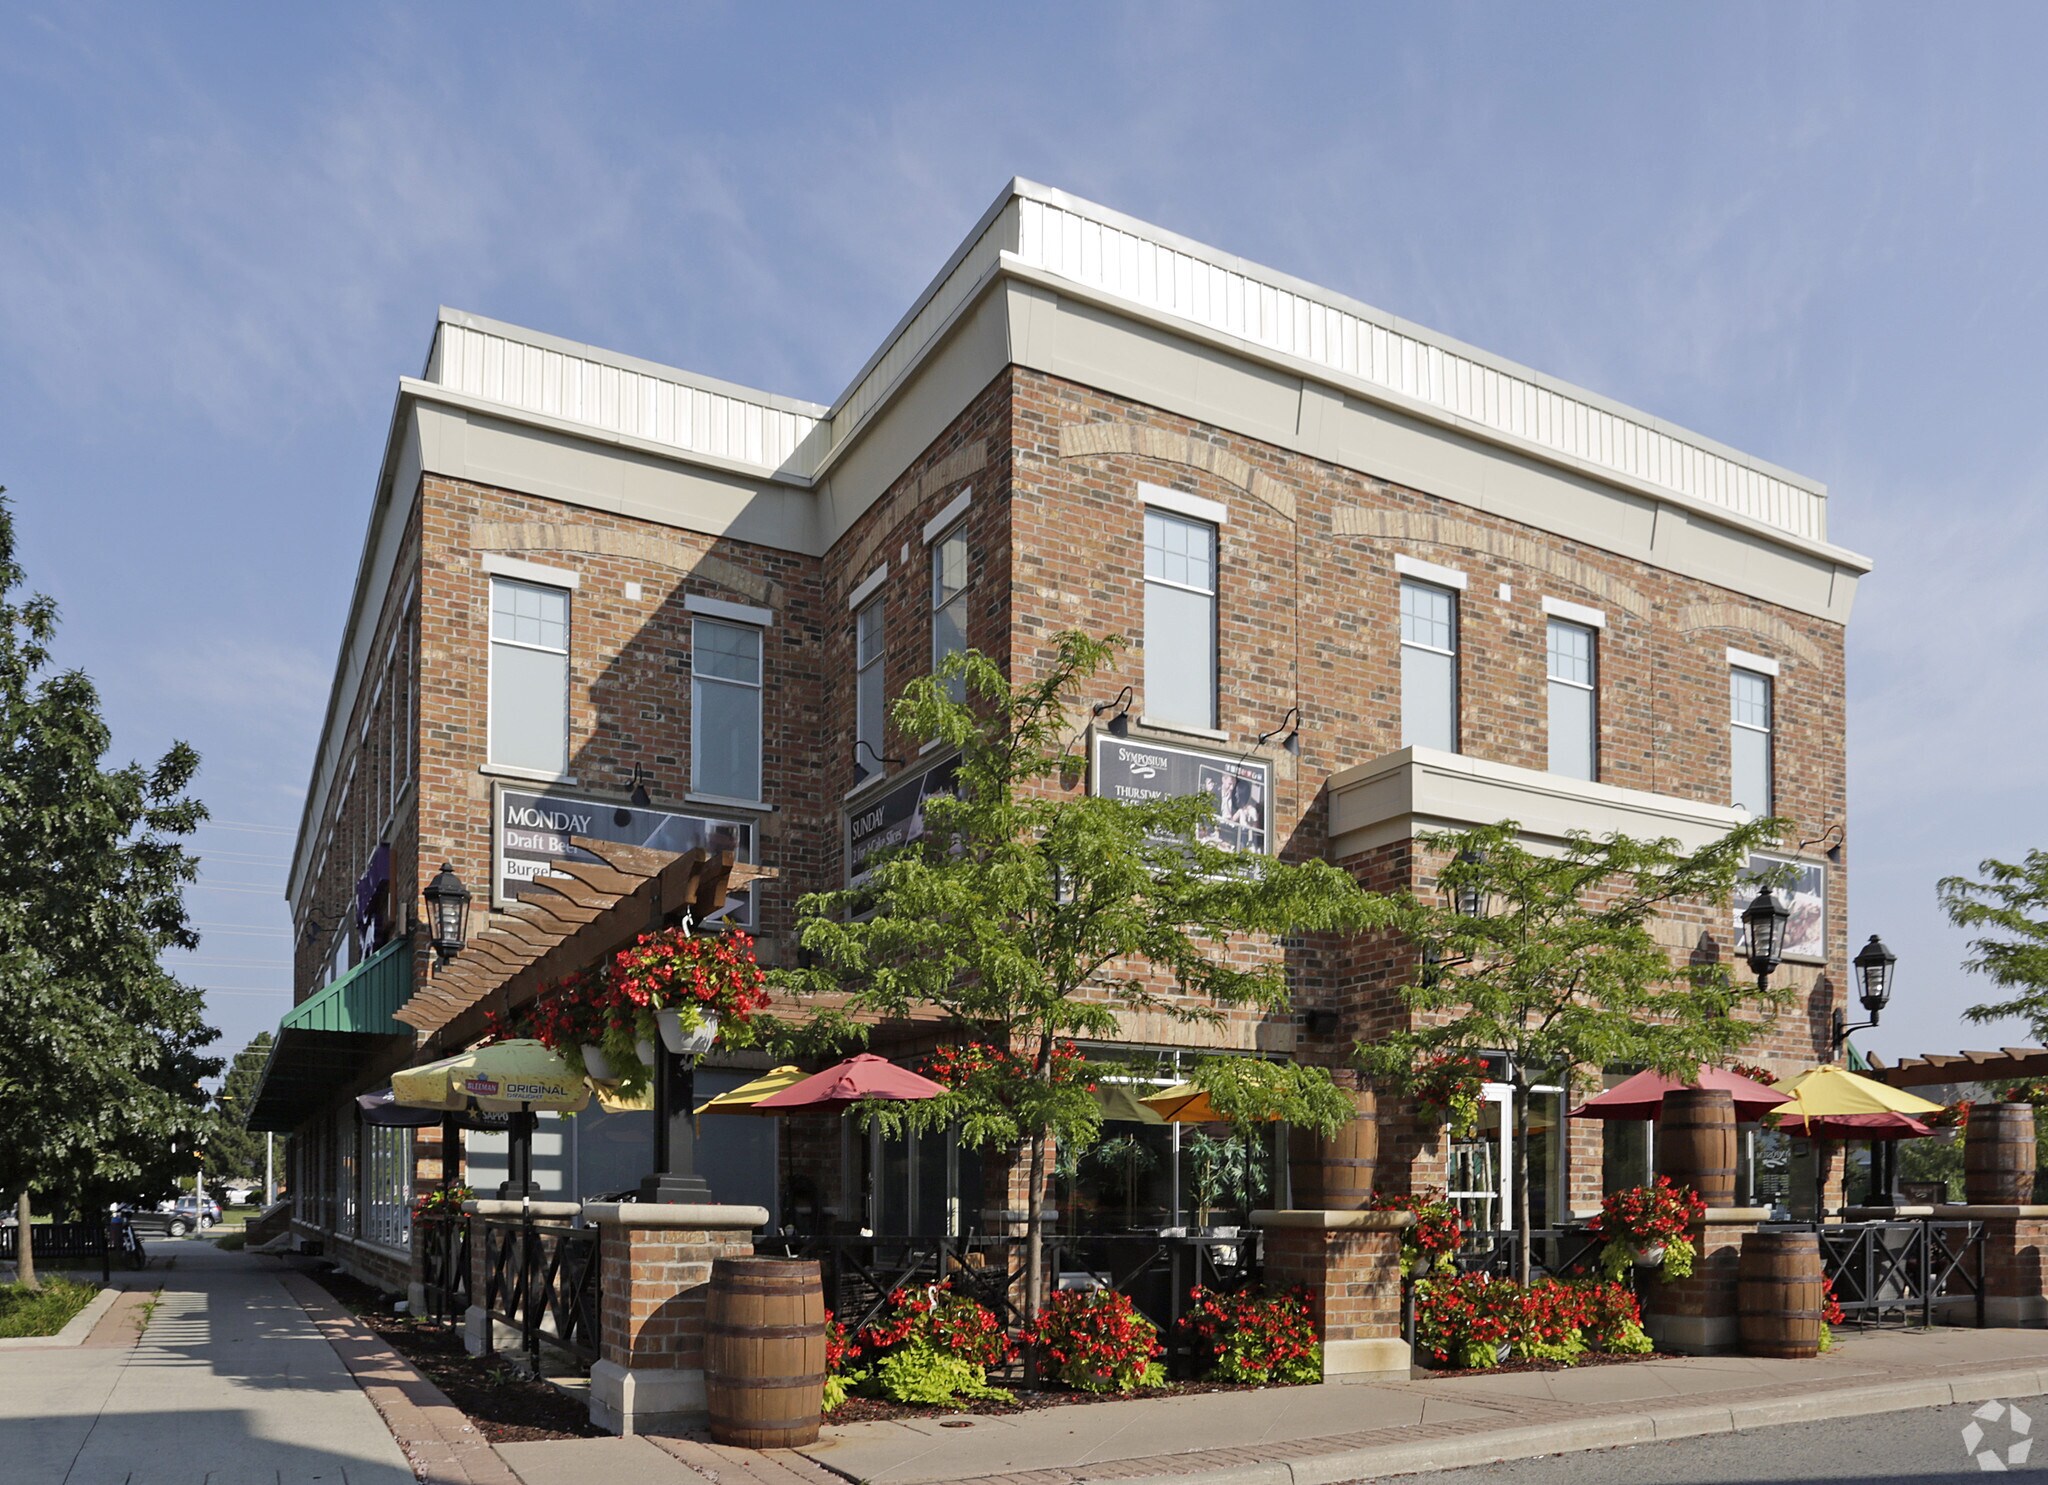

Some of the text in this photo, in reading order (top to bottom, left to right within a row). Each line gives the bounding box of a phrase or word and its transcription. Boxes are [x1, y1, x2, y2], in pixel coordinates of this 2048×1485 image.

[1118, 747, 1168, 768] SYMPOSIUM
[1115, 785, 1162, 800] THURSDAY
[507, 806, 592, 833] MONDAY
[852, 805, 885, 840] SUNDAY
[507, 832, 544, 850] Draft
[467, 1082, 568, 1096] SLEEMAN ORIGINAL
[506, 1092, 543, 1100] DRAUGHT
